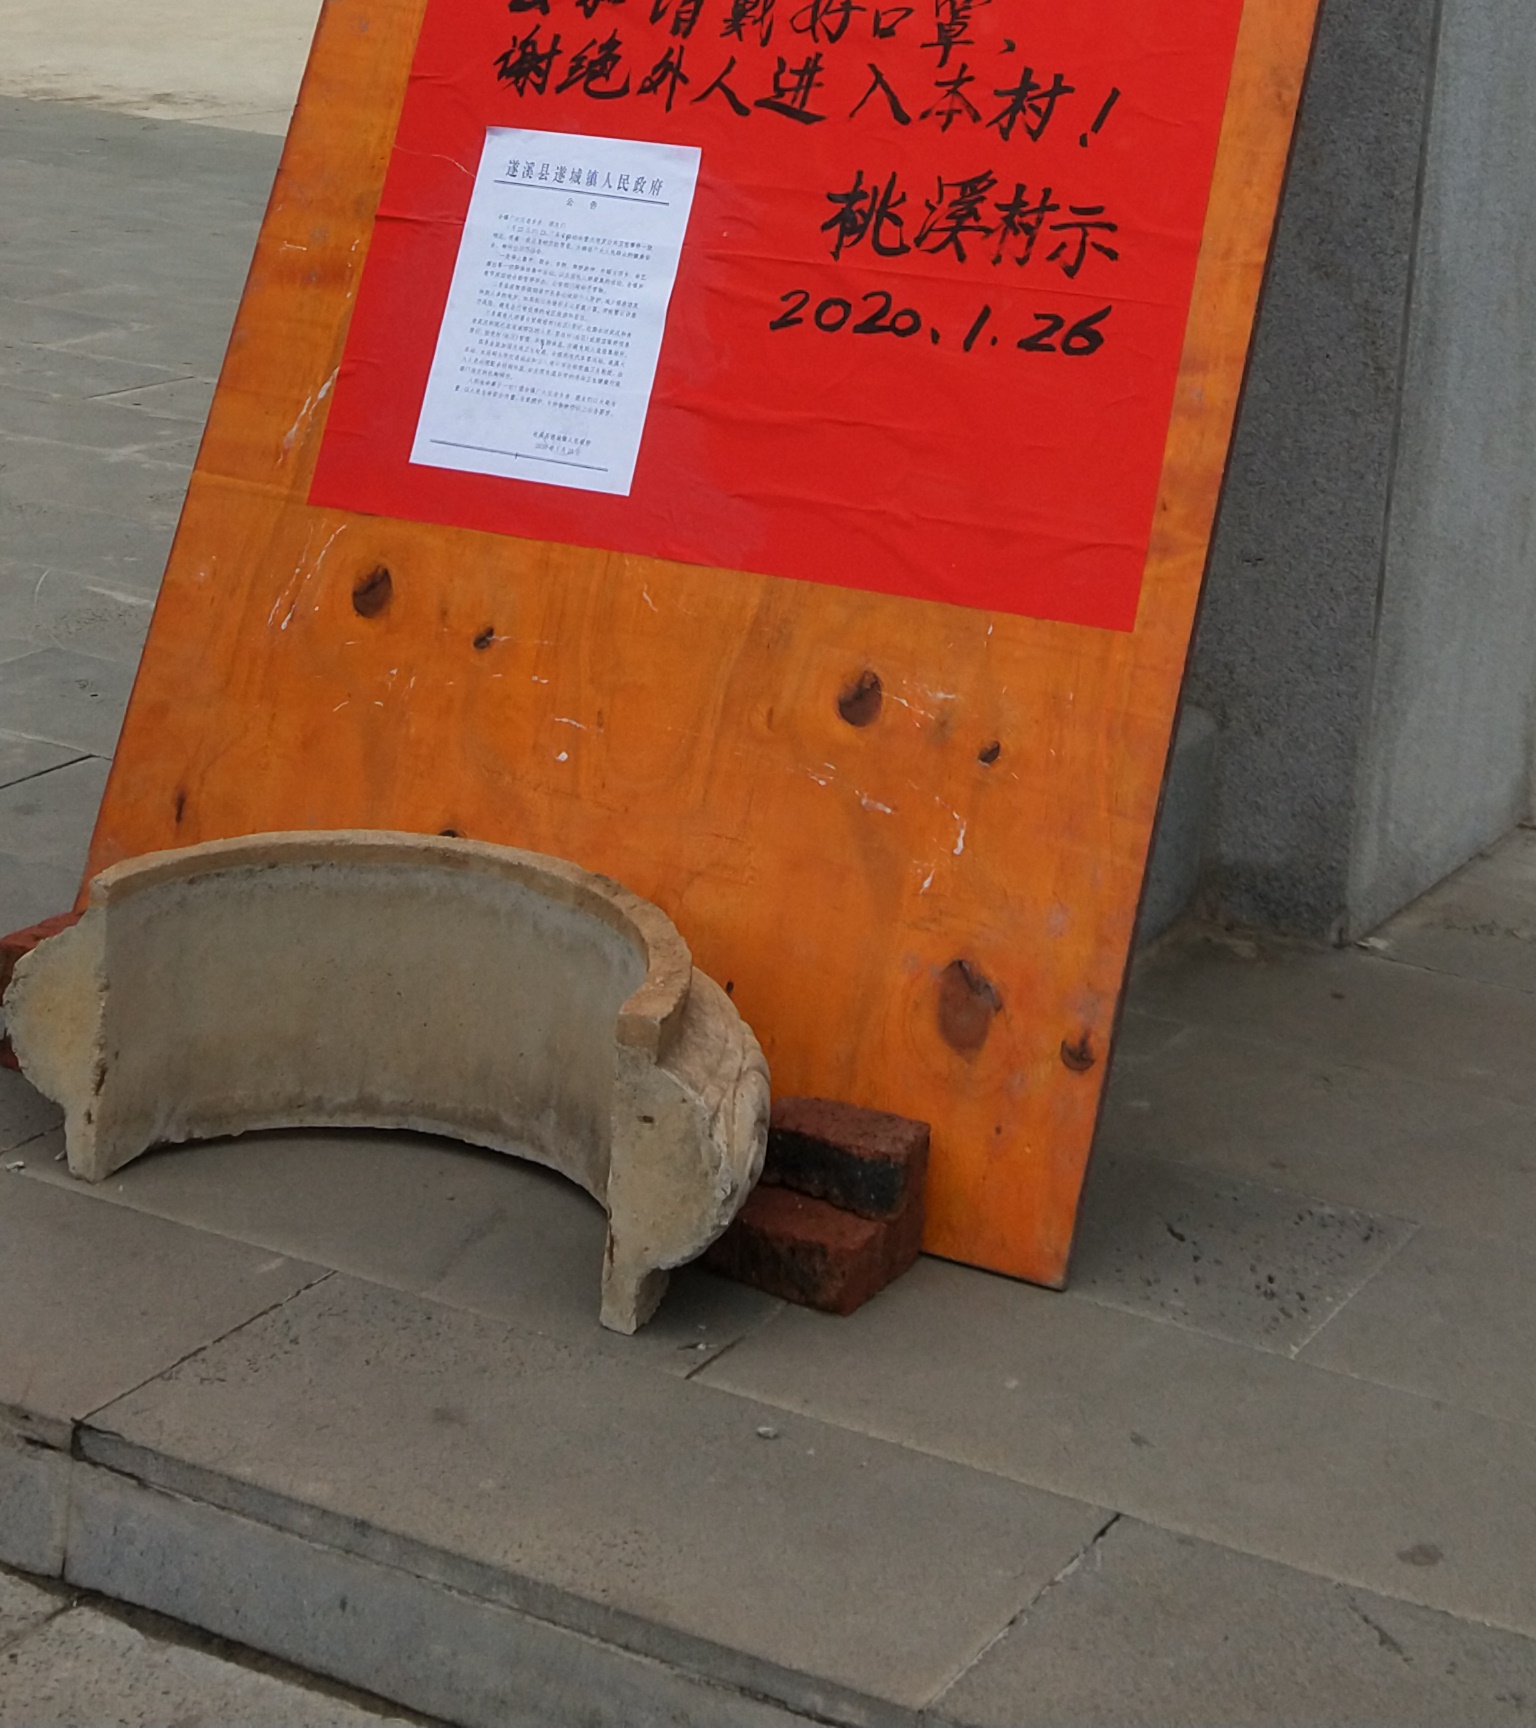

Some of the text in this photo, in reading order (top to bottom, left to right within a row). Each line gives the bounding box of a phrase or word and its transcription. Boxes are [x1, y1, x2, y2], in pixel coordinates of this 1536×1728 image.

[505, 159, 665, 196] 遂溪县遂城镇人民政府
[820, 170, 1120, 280] 桃溪村示
